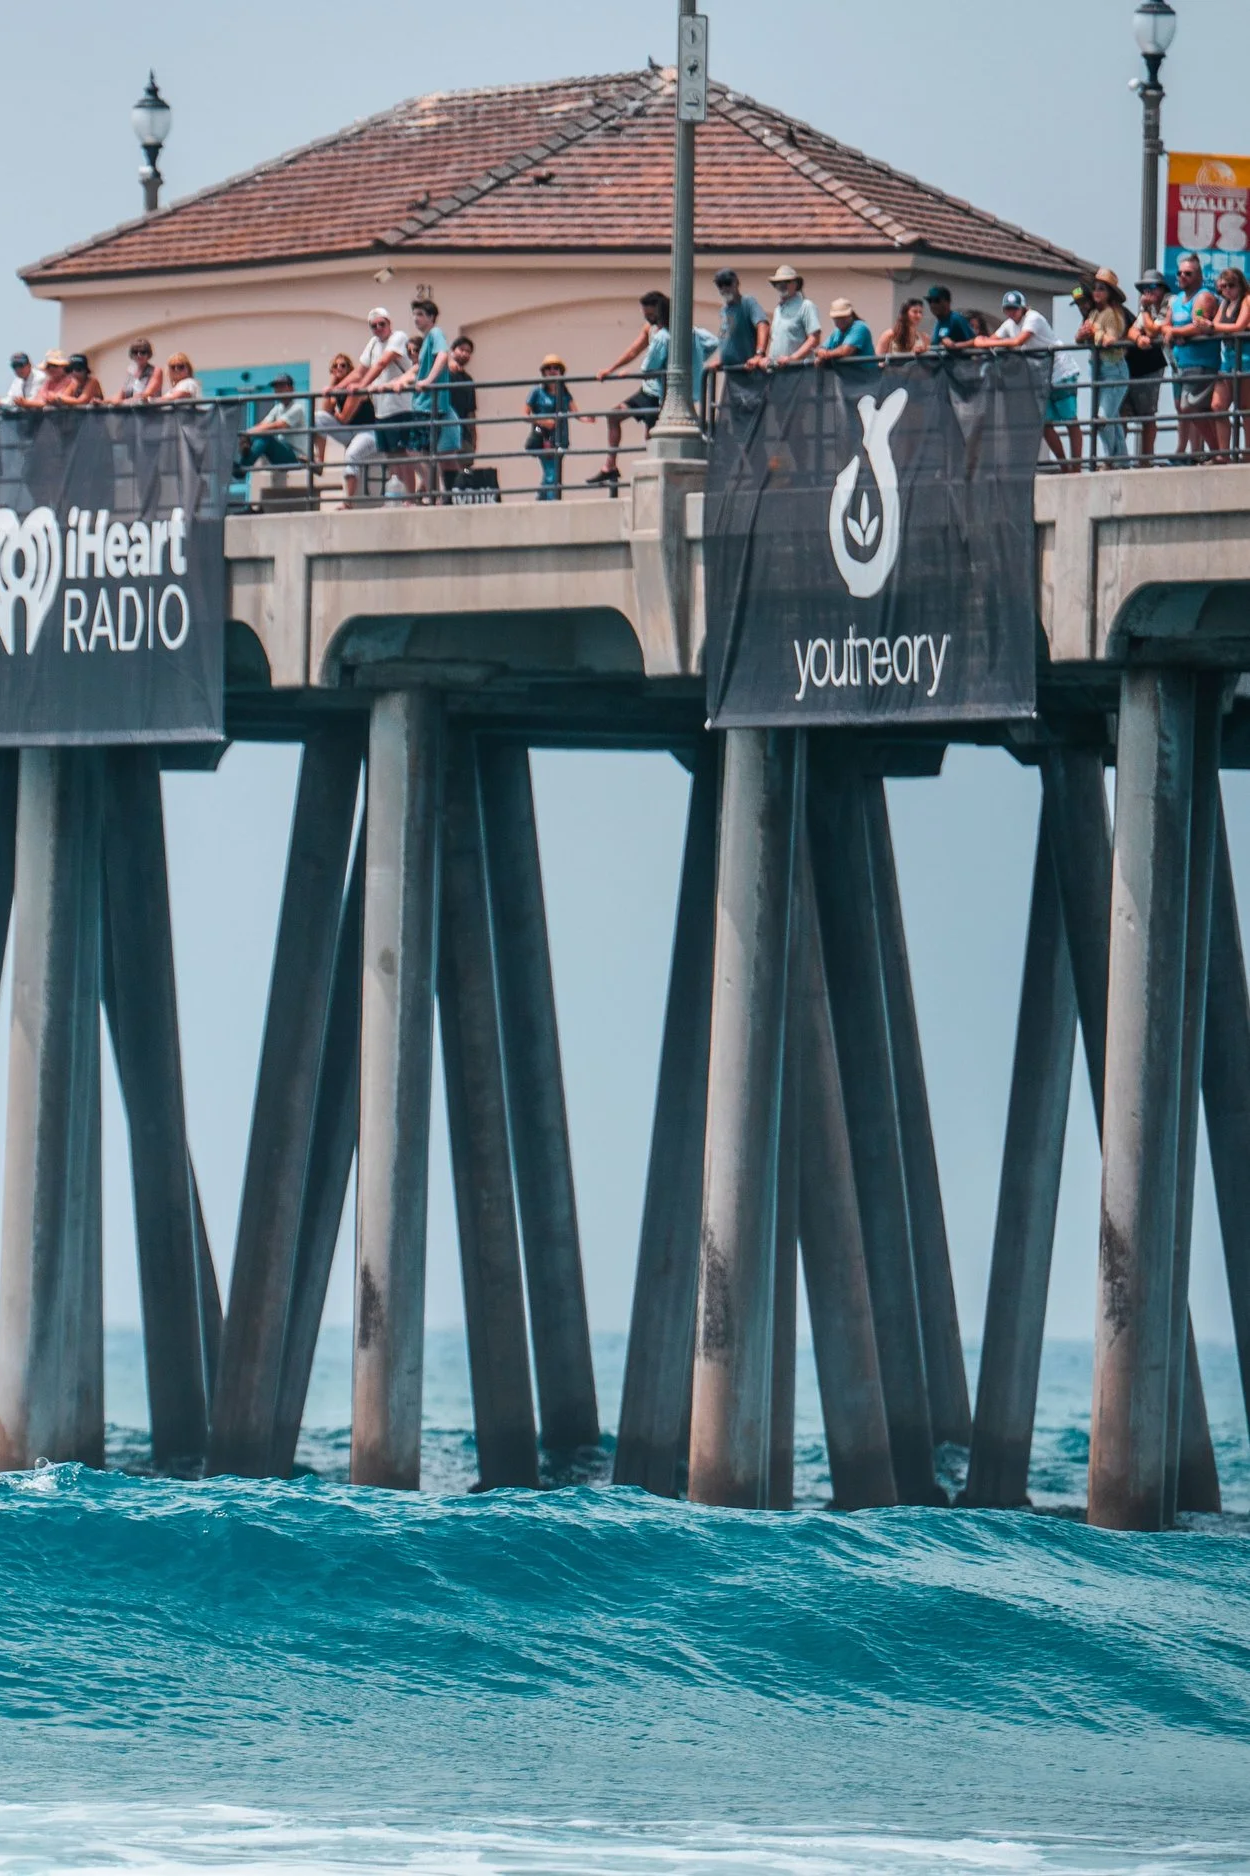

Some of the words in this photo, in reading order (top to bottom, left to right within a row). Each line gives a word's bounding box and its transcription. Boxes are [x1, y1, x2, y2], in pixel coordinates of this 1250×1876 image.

[1177, 210, 1247, 251] US
[1179, 195, 1247, 213] WALLEX
[66, 506, 187, 579] iHeart
[63, 584, 190, 653] RADIO
